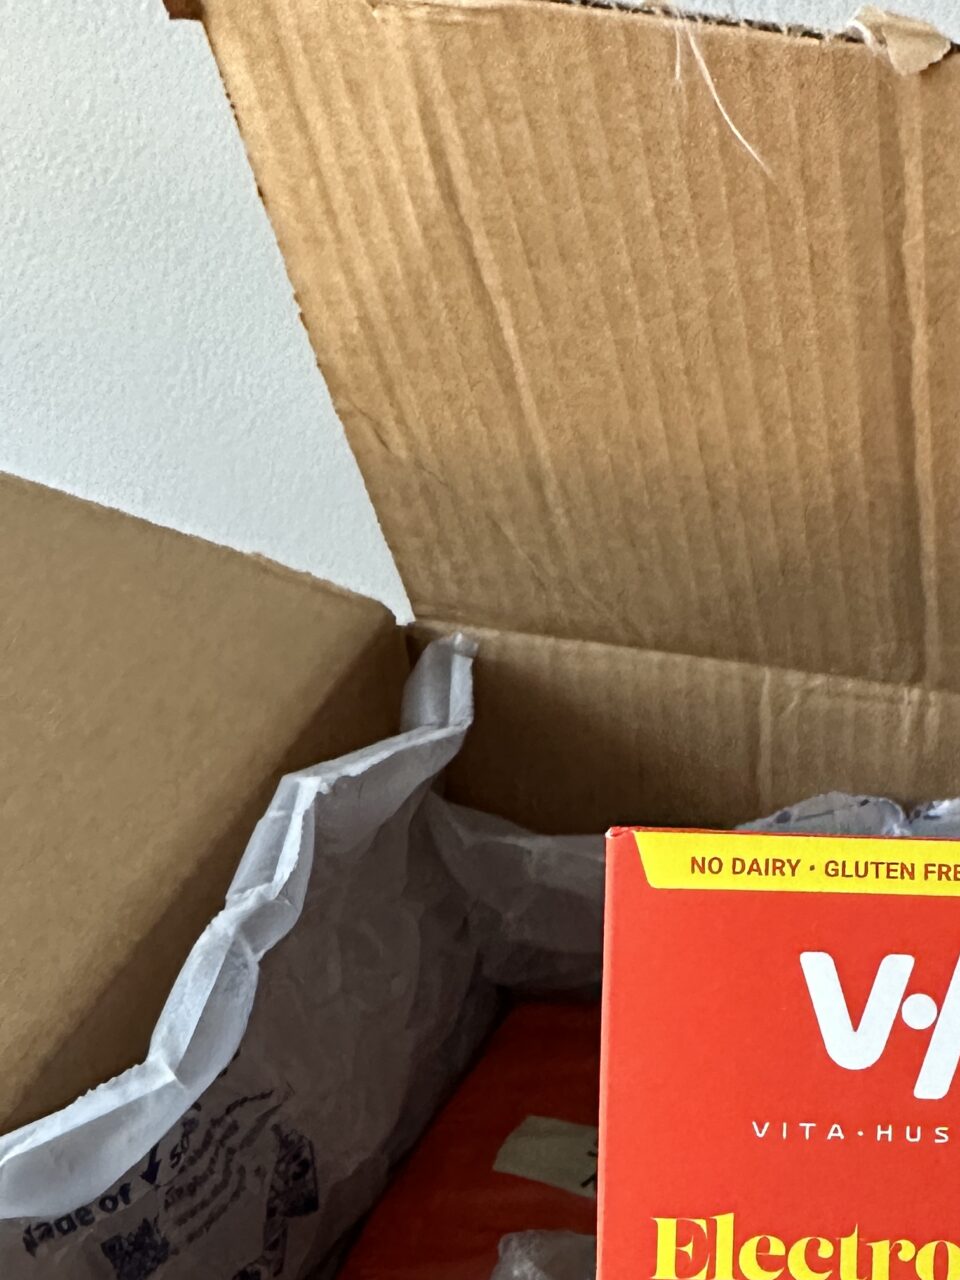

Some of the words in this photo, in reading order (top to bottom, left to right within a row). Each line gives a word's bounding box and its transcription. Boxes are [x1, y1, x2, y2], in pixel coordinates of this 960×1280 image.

[691, 857, 723, 874] NO
[732, 858, 800, 876] DAIRY
[825, 860, 914, 880] GLUTEN
